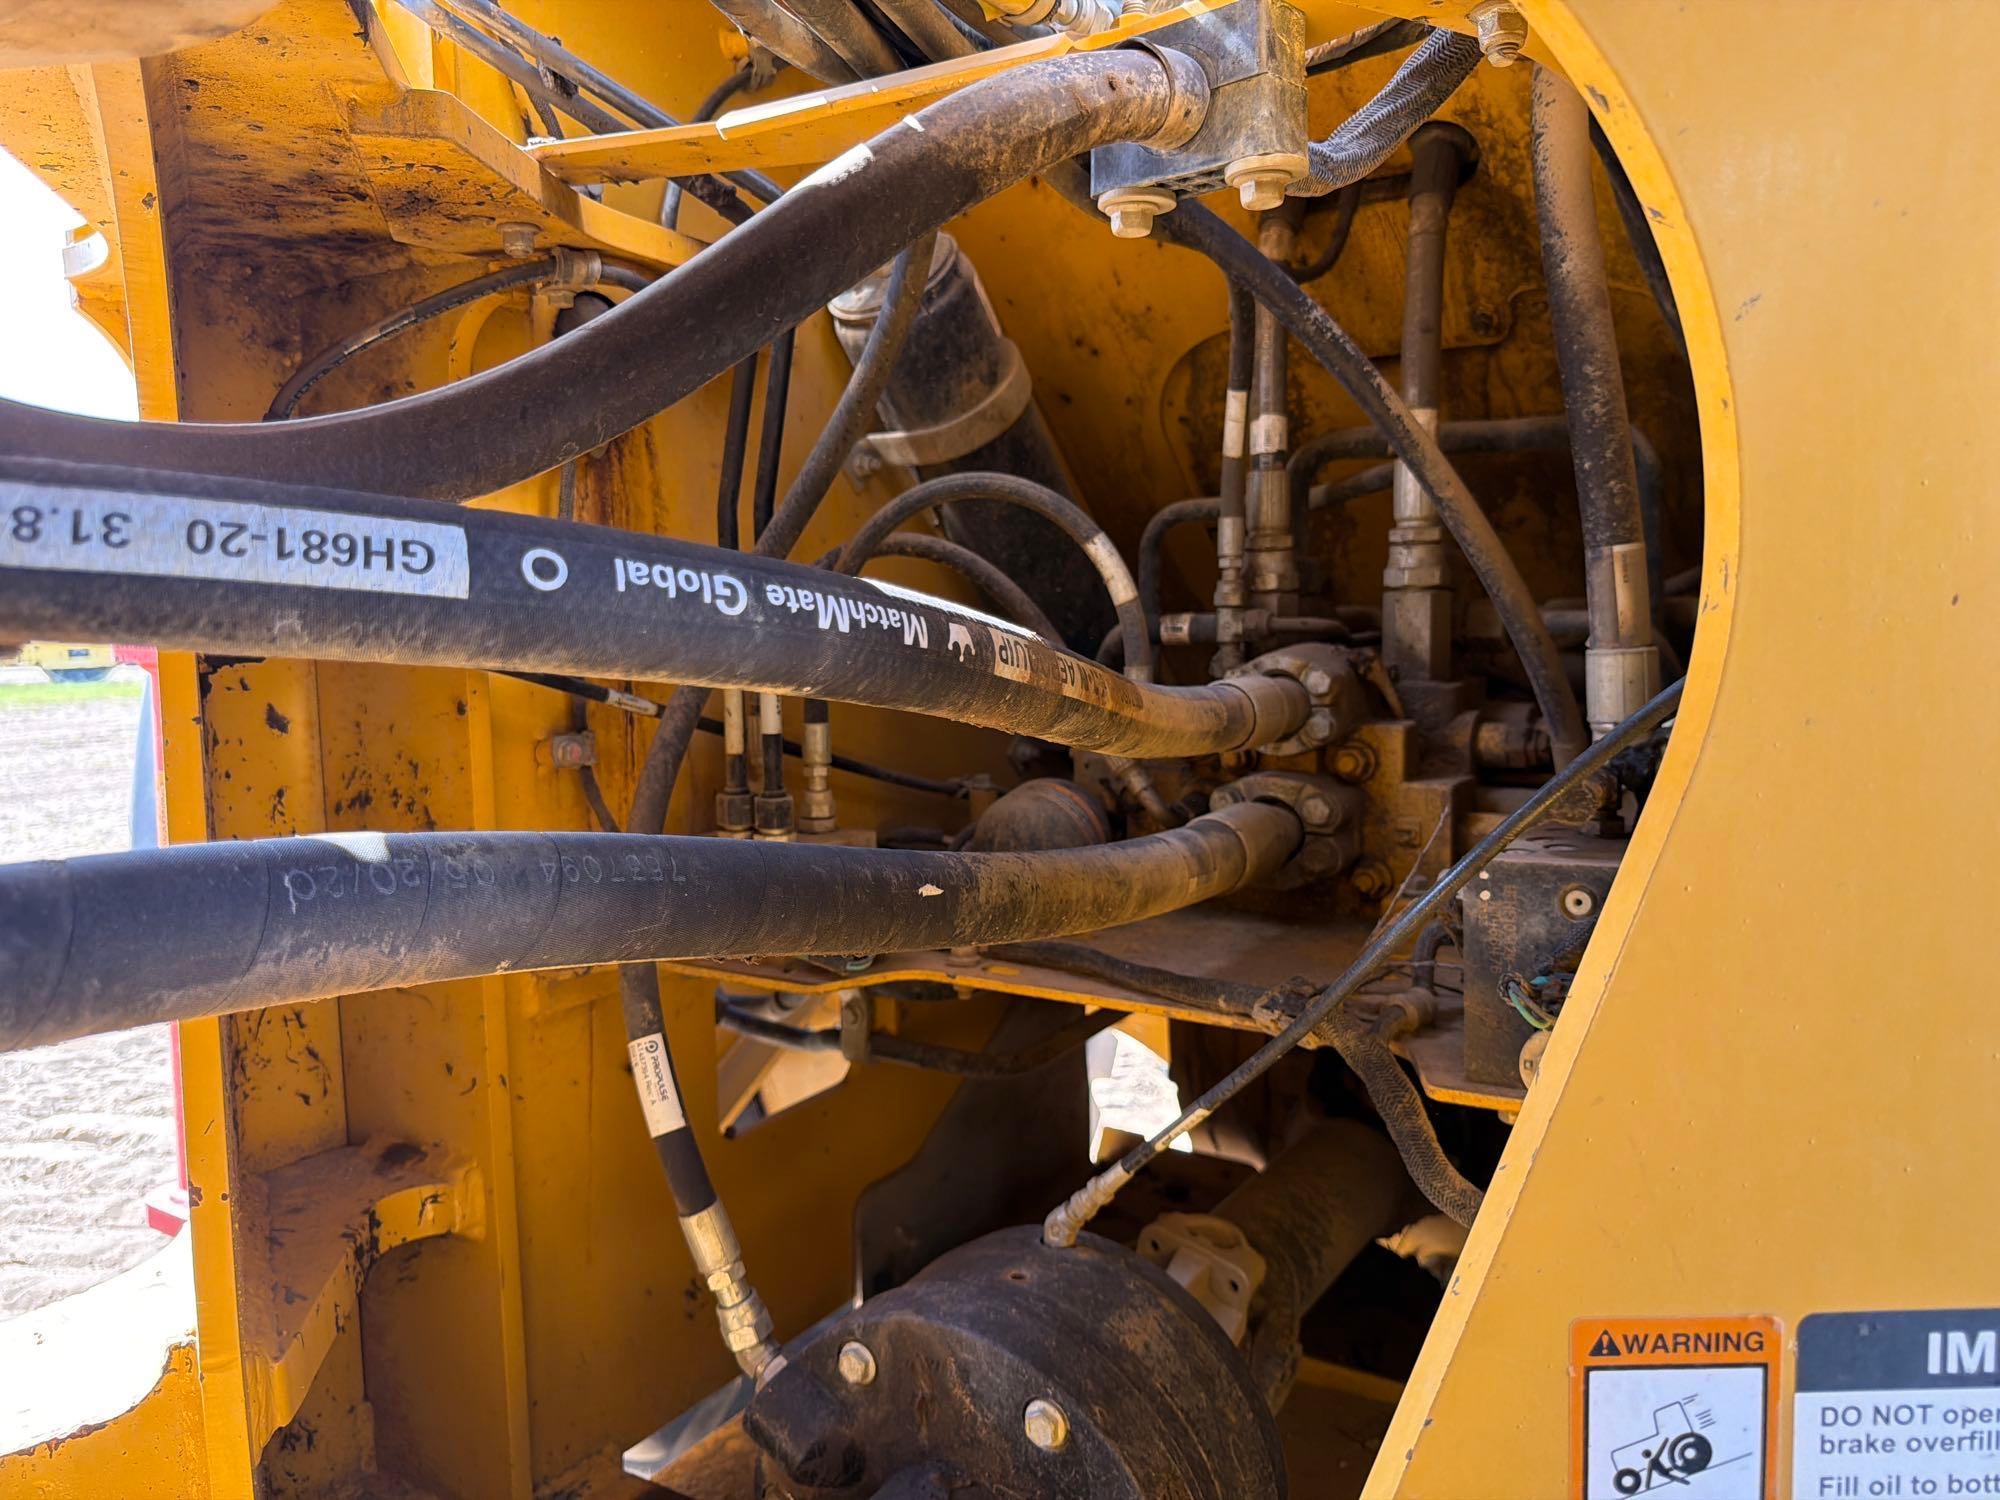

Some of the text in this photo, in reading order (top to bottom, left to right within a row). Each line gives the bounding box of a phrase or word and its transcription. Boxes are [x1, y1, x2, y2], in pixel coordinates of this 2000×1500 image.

[11, 505, 132, 549] 31.8
[186, 519, 436, 575] GH681-20
[613, 557, 749, 616] Global
[765, 583, 929, 649] MatchMate
[651, 1056, 669, 1101] PROPULSE
[1621, 1329, 1766, 1355] WARNING
[1927, 1329, 1997, 1376] IM
[1820, 1405, 1863, 1428] DO
[1872, 1403, 1935, 1427] NOT
[1819, 1432, 1897, 1455] brake
[1818, 1473, 2000, 1498] Fill oil to bott
